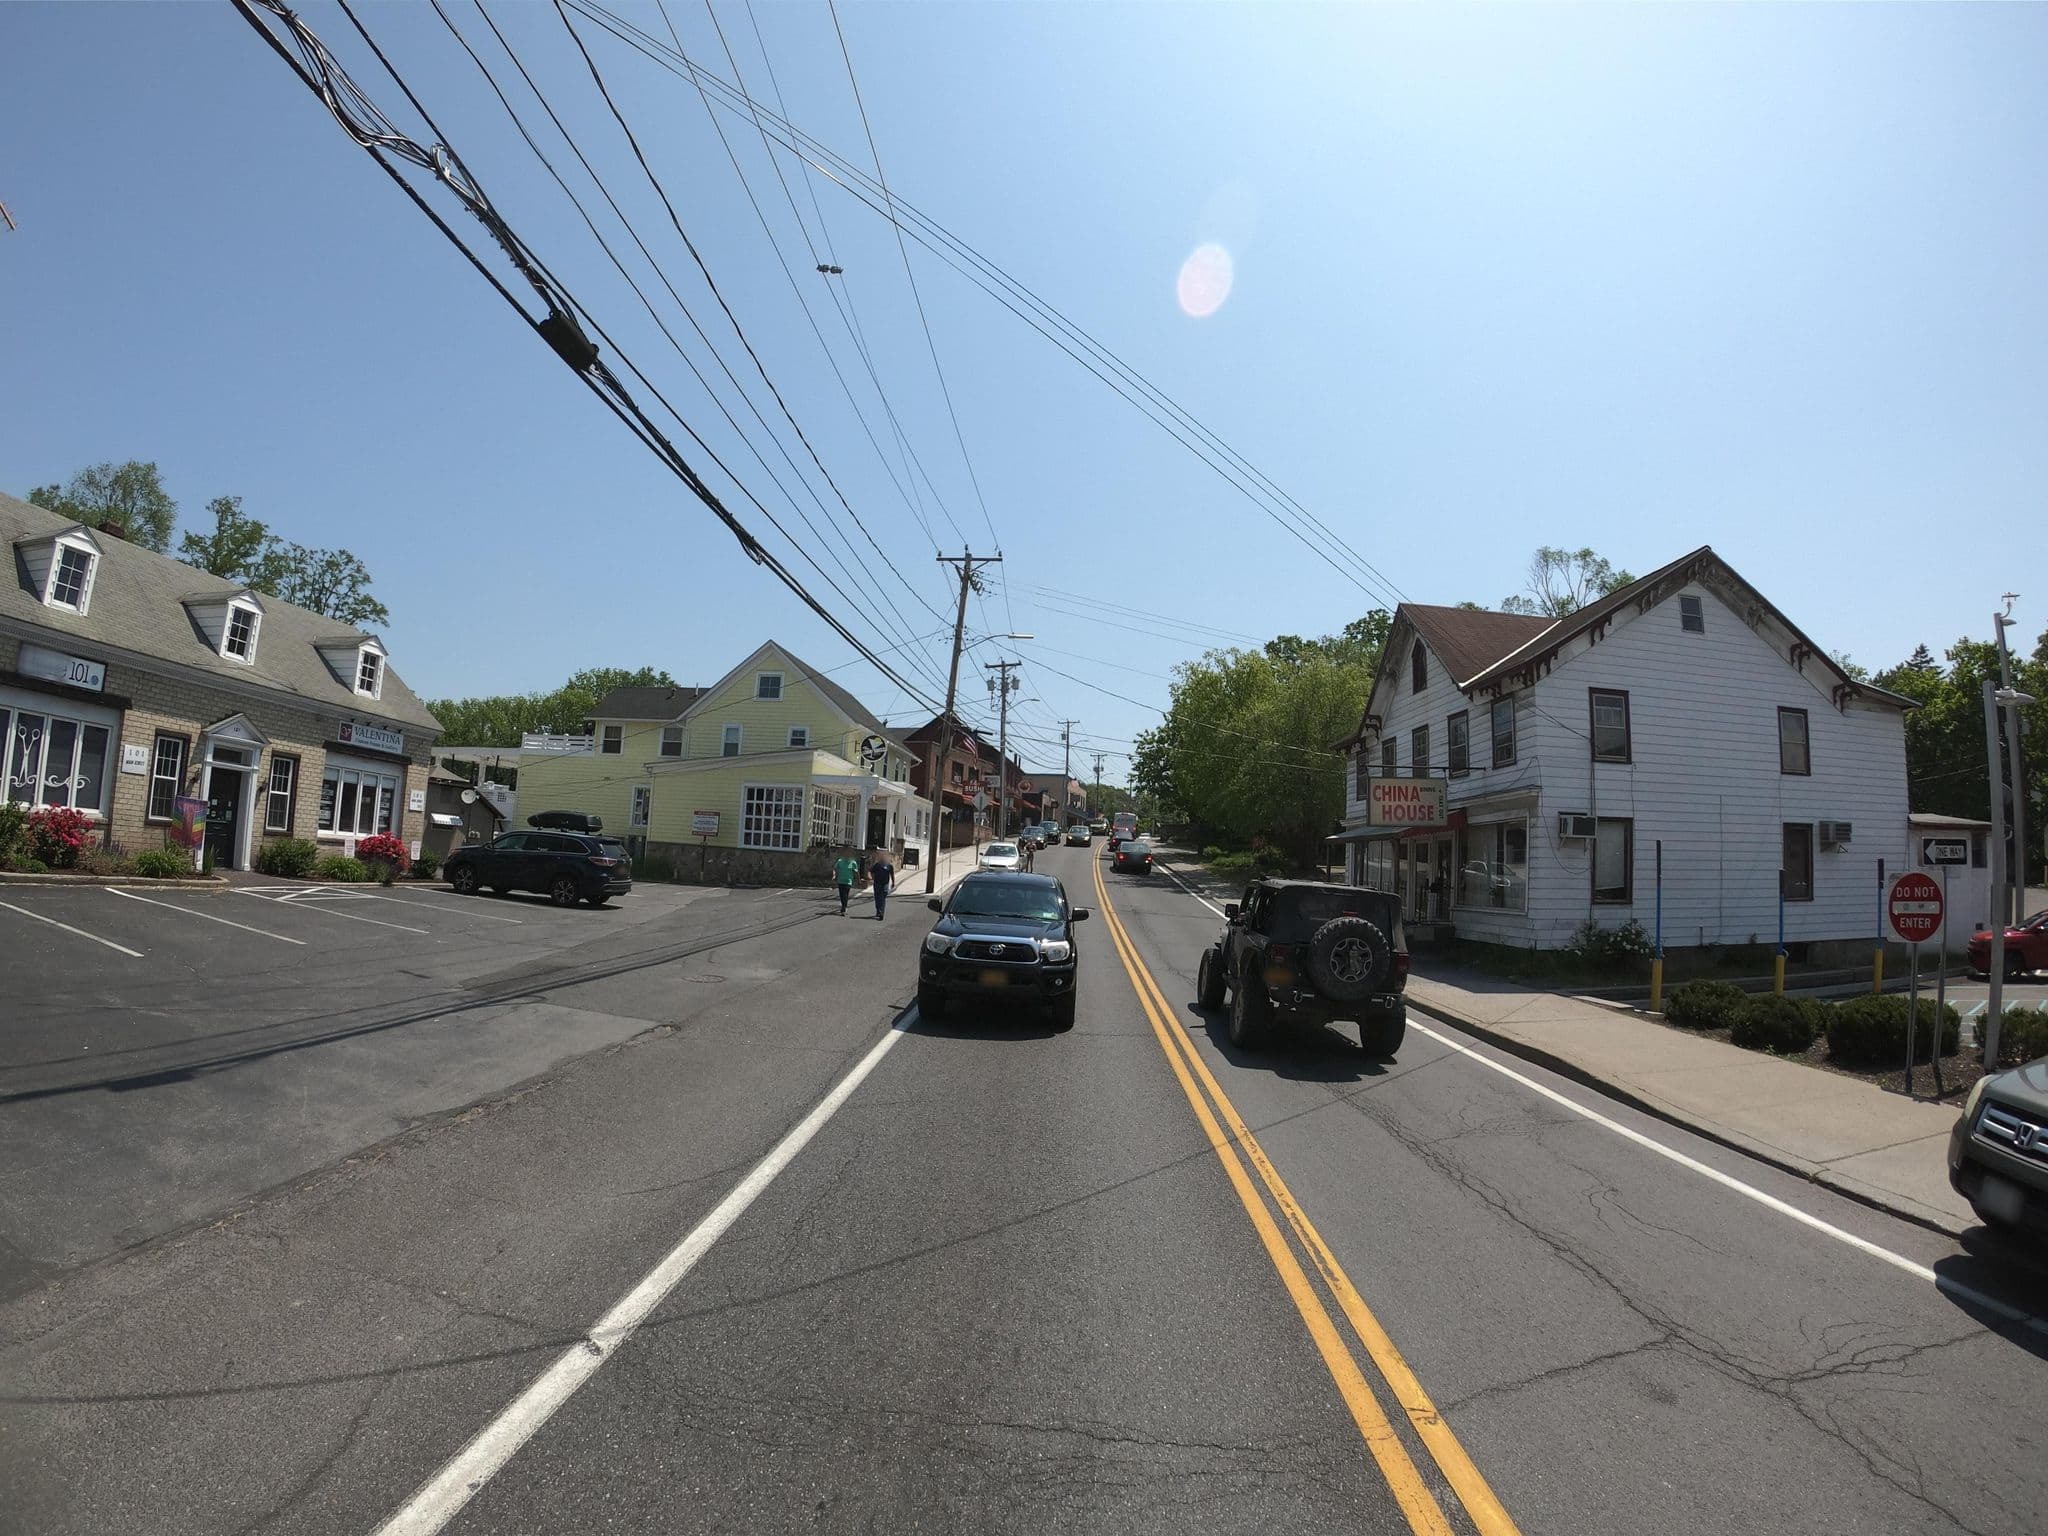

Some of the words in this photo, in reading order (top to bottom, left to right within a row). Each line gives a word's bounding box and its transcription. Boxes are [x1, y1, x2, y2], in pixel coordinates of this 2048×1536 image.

[69, 661, 90, 684] 101
[354, 726, 401, 745] VALENTINA
[1372, 785, 1420, 802] CHINA
[1382, 805, 1434, 821] HOUSE
[1935, 847, 1948, 857] ONE
[1949, 847, 1962, 857] WAY
[1896, 886, 1911, 897] DO
[1914, 886, 1935, 897] NOT
[1899, 917, 1931, 929] ENTER
